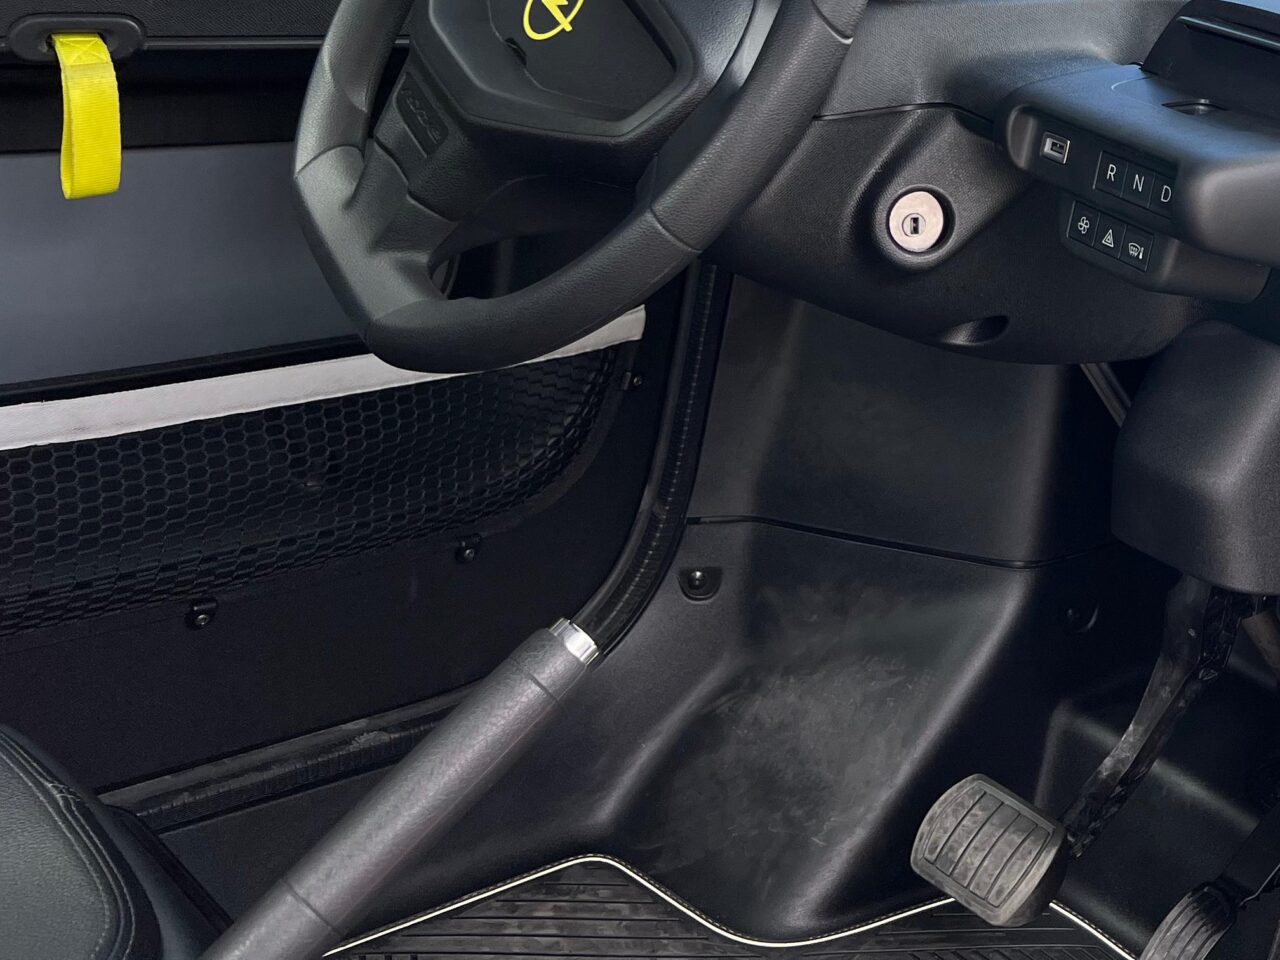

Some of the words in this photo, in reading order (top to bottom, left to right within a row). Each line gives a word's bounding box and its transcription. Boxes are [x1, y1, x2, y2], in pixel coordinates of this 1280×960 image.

[1106, 163, 1117, 182] R
[1132, 173, 1145, 193] N
[1160, 184, 1172, 203] D
